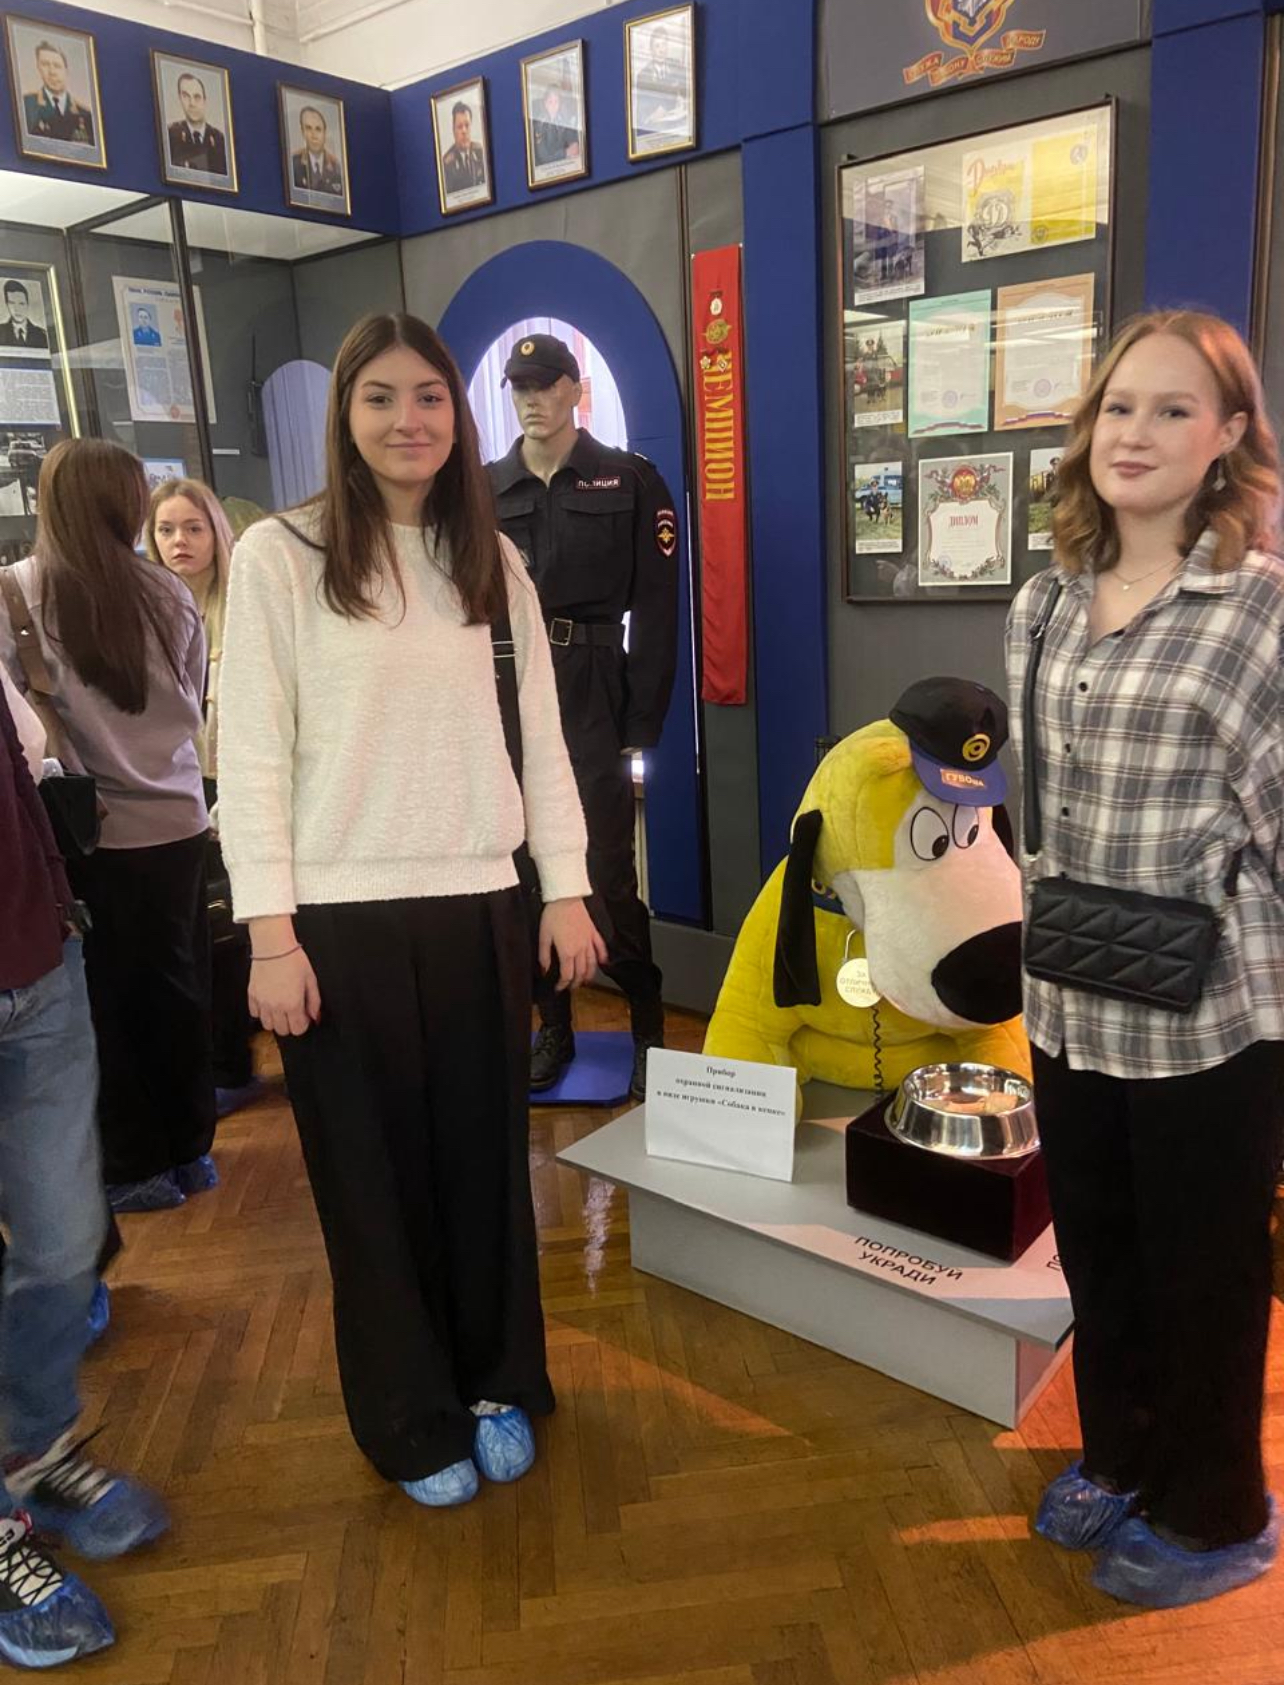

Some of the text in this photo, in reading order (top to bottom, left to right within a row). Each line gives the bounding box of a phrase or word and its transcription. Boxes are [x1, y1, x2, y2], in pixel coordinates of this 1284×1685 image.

[706, 1066, 736, 1078] Прибор
[855, 1235, 963, 1281] ПОПРОБУЙ
[858, 1251, 937, 1285] УКРАДИ
